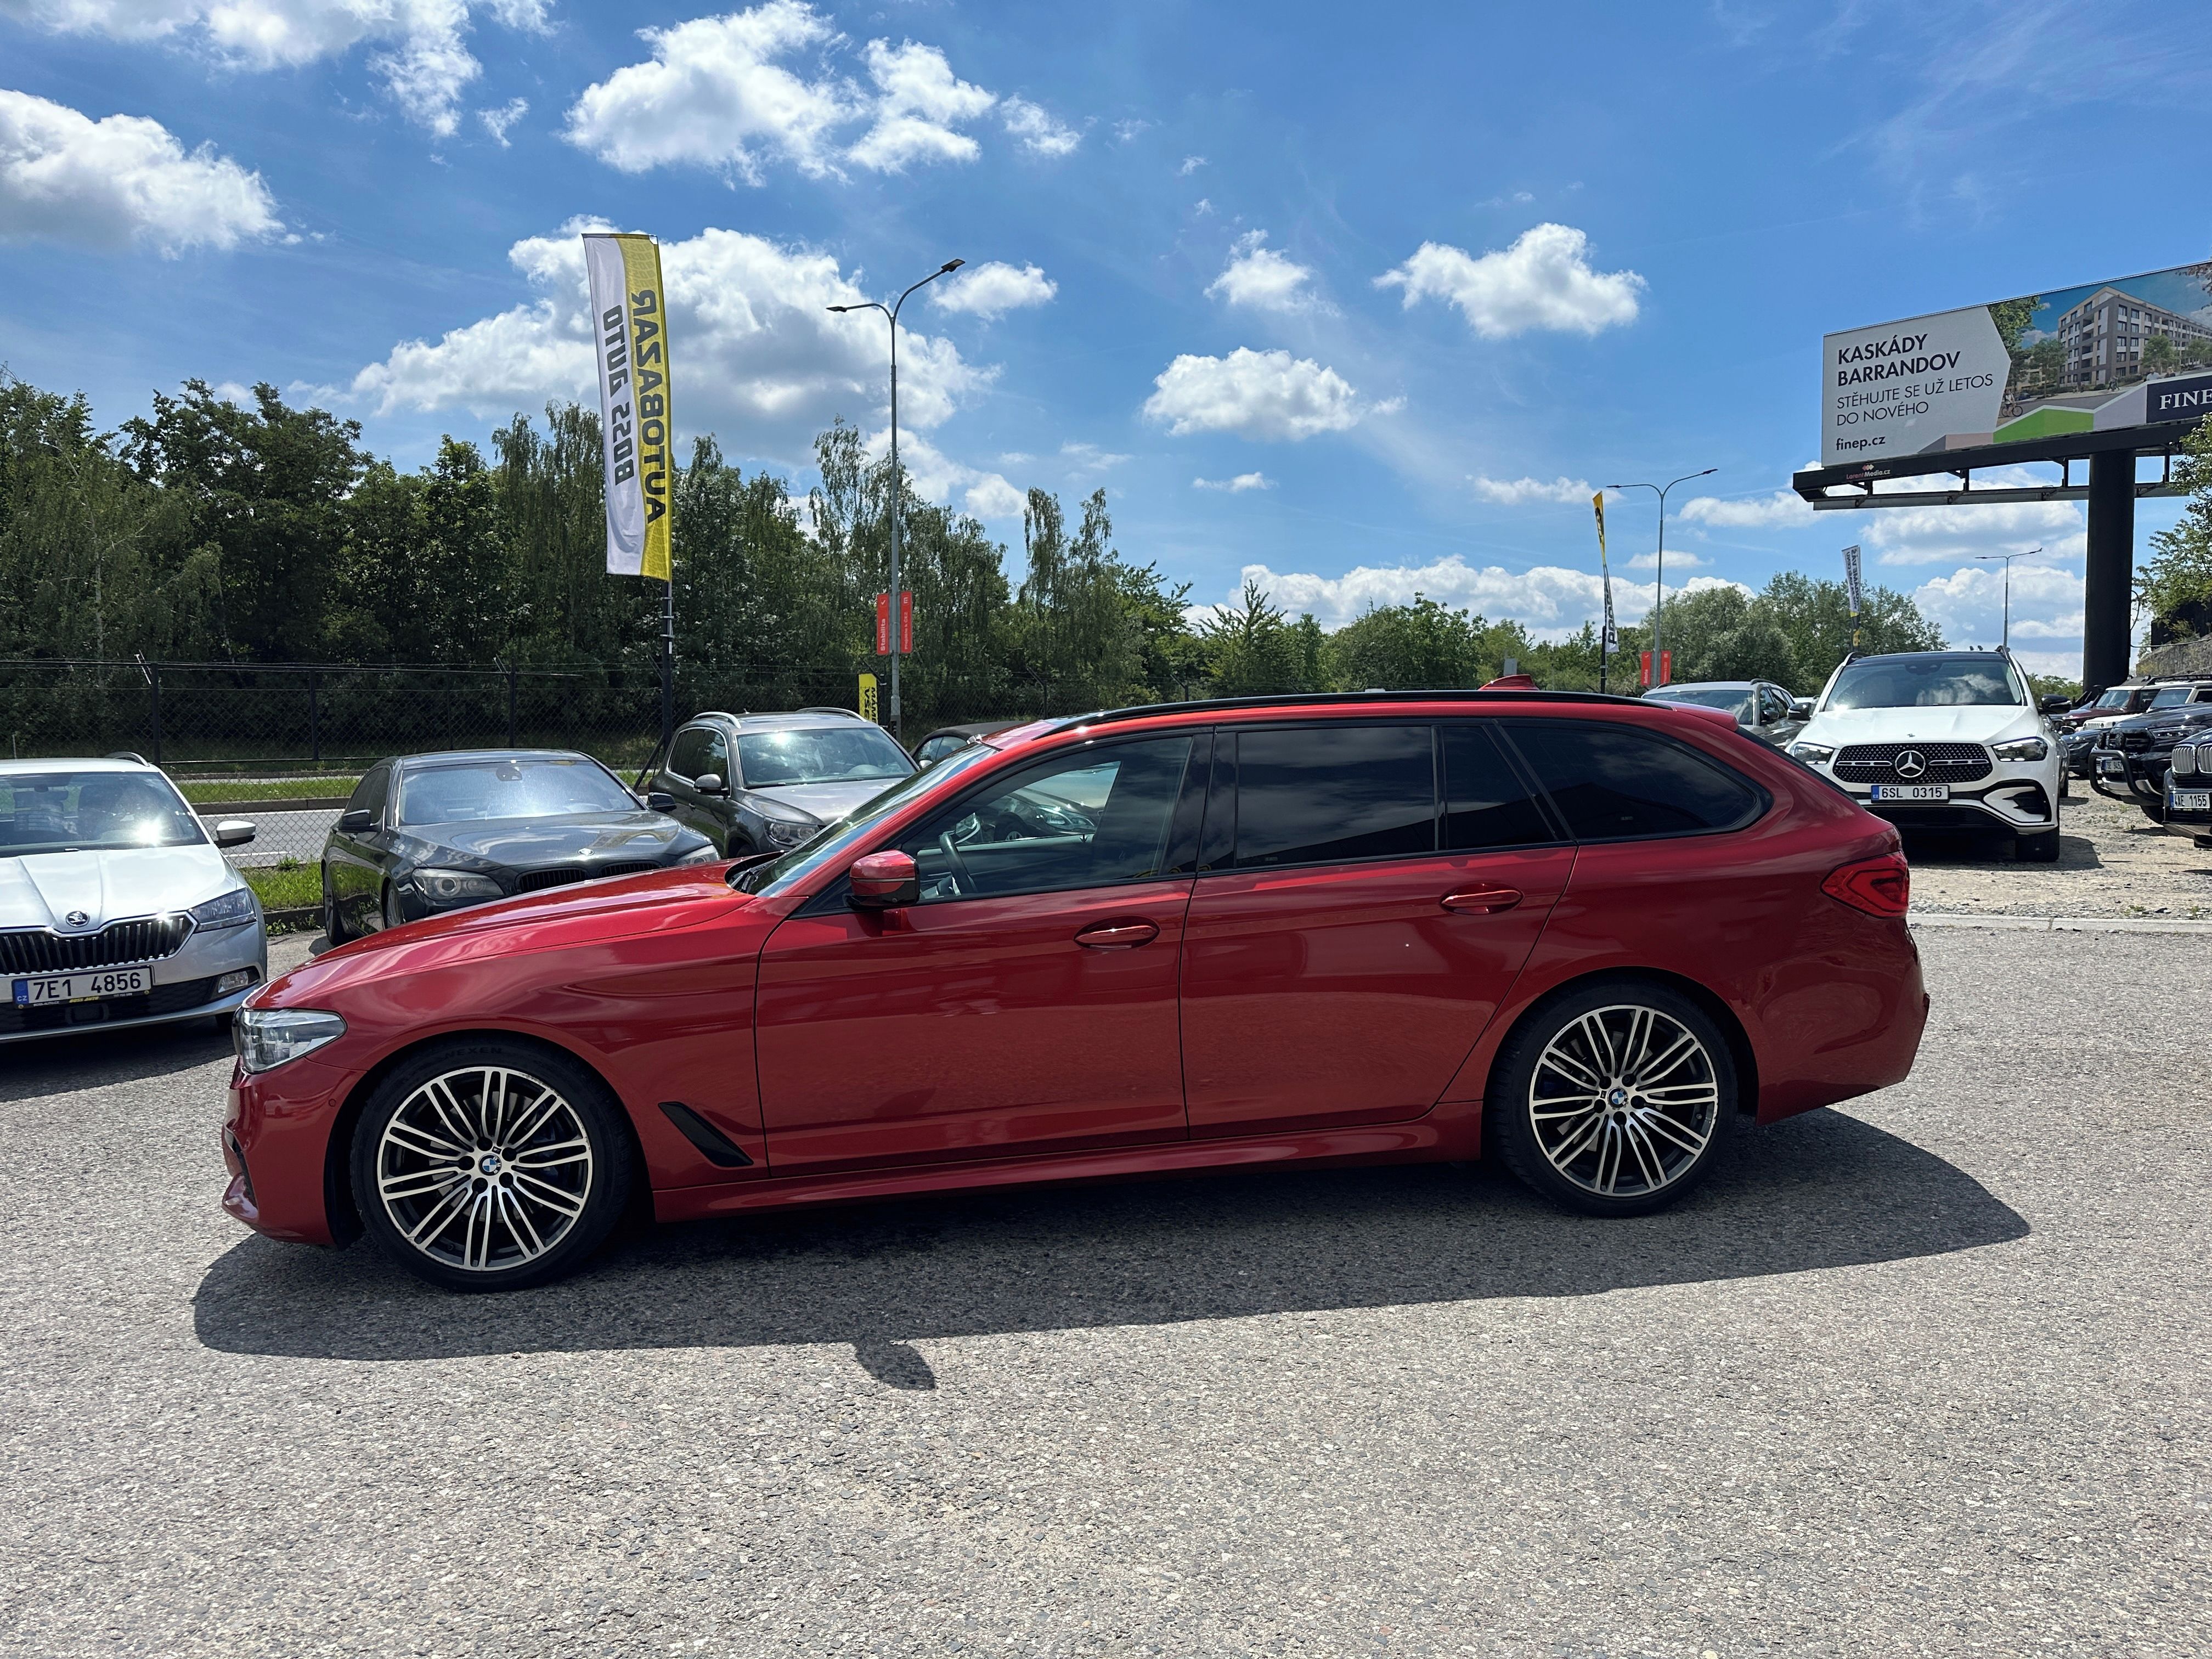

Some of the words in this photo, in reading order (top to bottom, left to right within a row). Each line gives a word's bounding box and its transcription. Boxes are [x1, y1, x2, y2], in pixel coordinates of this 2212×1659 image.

[1838, 334, 1928, 364] KASKÁDY
[1838, 351, 1961, 386] BARRANDOV
[1837, 388, 1900, 409] STĚHUJTE
[1905, 385, 1920, 398] SE
[1925, 378, 1944, 395] UŽ
[1949, 374, 1993, 392] LETOS
[1837, 413, 1859, 426] DO
[1864, 401, 1928, 422] NOVÉHO
[1836, 436, 1886, 450] finep.cz
[1882, 787, 1903, 798] 6SL
[1912, 787, 1942, 798] 0315
[2175, 795, 2185, 806] 4AE
[2189, 795, 2207, 806] 1155
[33, 979, 71, 1000] 7E1
[91, 972, 141, 993] 4856
